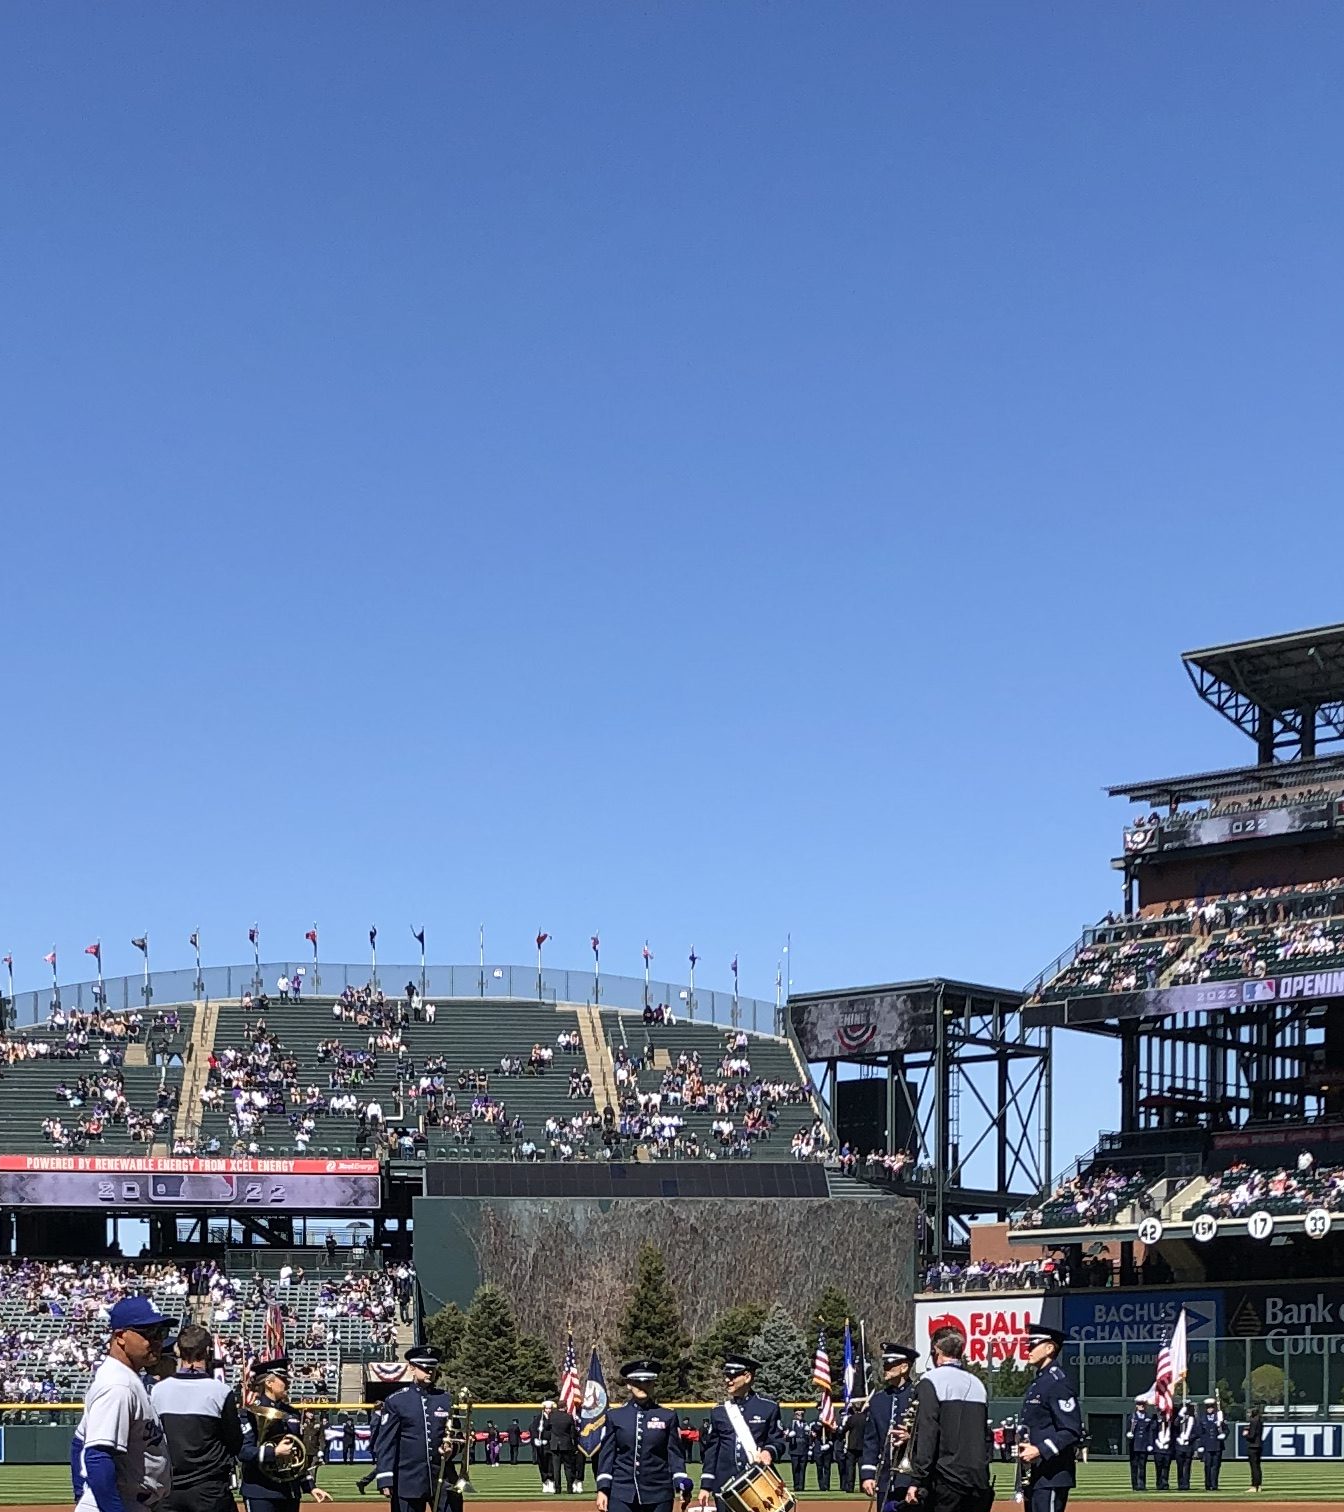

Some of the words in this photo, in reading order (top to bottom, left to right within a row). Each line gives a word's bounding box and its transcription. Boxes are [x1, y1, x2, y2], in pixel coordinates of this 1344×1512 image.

[1197, 988, 1238, 1002] 2022
[27, 1157, 74, 1170] POWERED
[77, 1158, 92, 1170] BY
[95, 1158, 154, 1171] RENEWABLE
[157, 1159, 194, 1171] ENERGY
[198, 1159, 226, 1172] FROM
[229, 1160, 254, 1172] XCEL
[257, 1160, 295, 1172] ENERGY
[1141, 1224, 1156, 1240] 42
[1253, 1218, 1267, 1236] 17
[1309, 1216, 1326, 1233] 33
[1094, 1301, 1176, 1323] BACHUS
[1265, 1293, 1334, 1325] Bank
[1260, 1425, 1335, 1456] YETI
